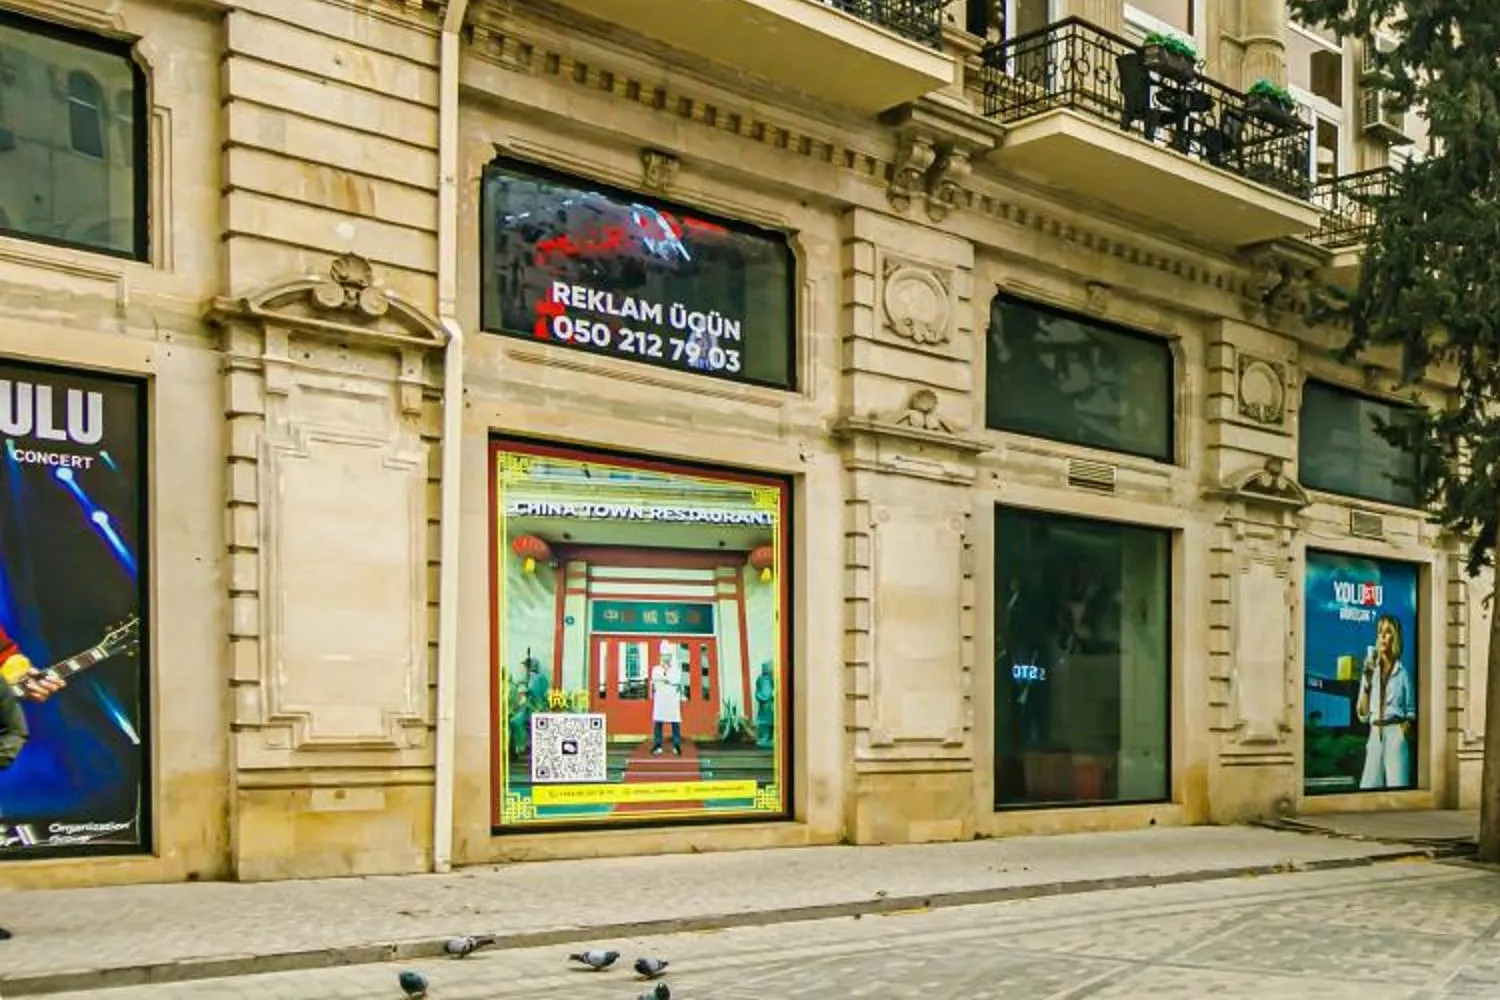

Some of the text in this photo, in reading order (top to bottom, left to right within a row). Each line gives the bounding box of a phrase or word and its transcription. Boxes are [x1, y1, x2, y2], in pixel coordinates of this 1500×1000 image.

[553, 282, 663, 325] REKLAM
[553, 315, 741, 373] 050 212 79 03
[13, 449, 94, 470] CONCERT
[516, 502, 775, 525] CHINA TOWN RESTAURANT
